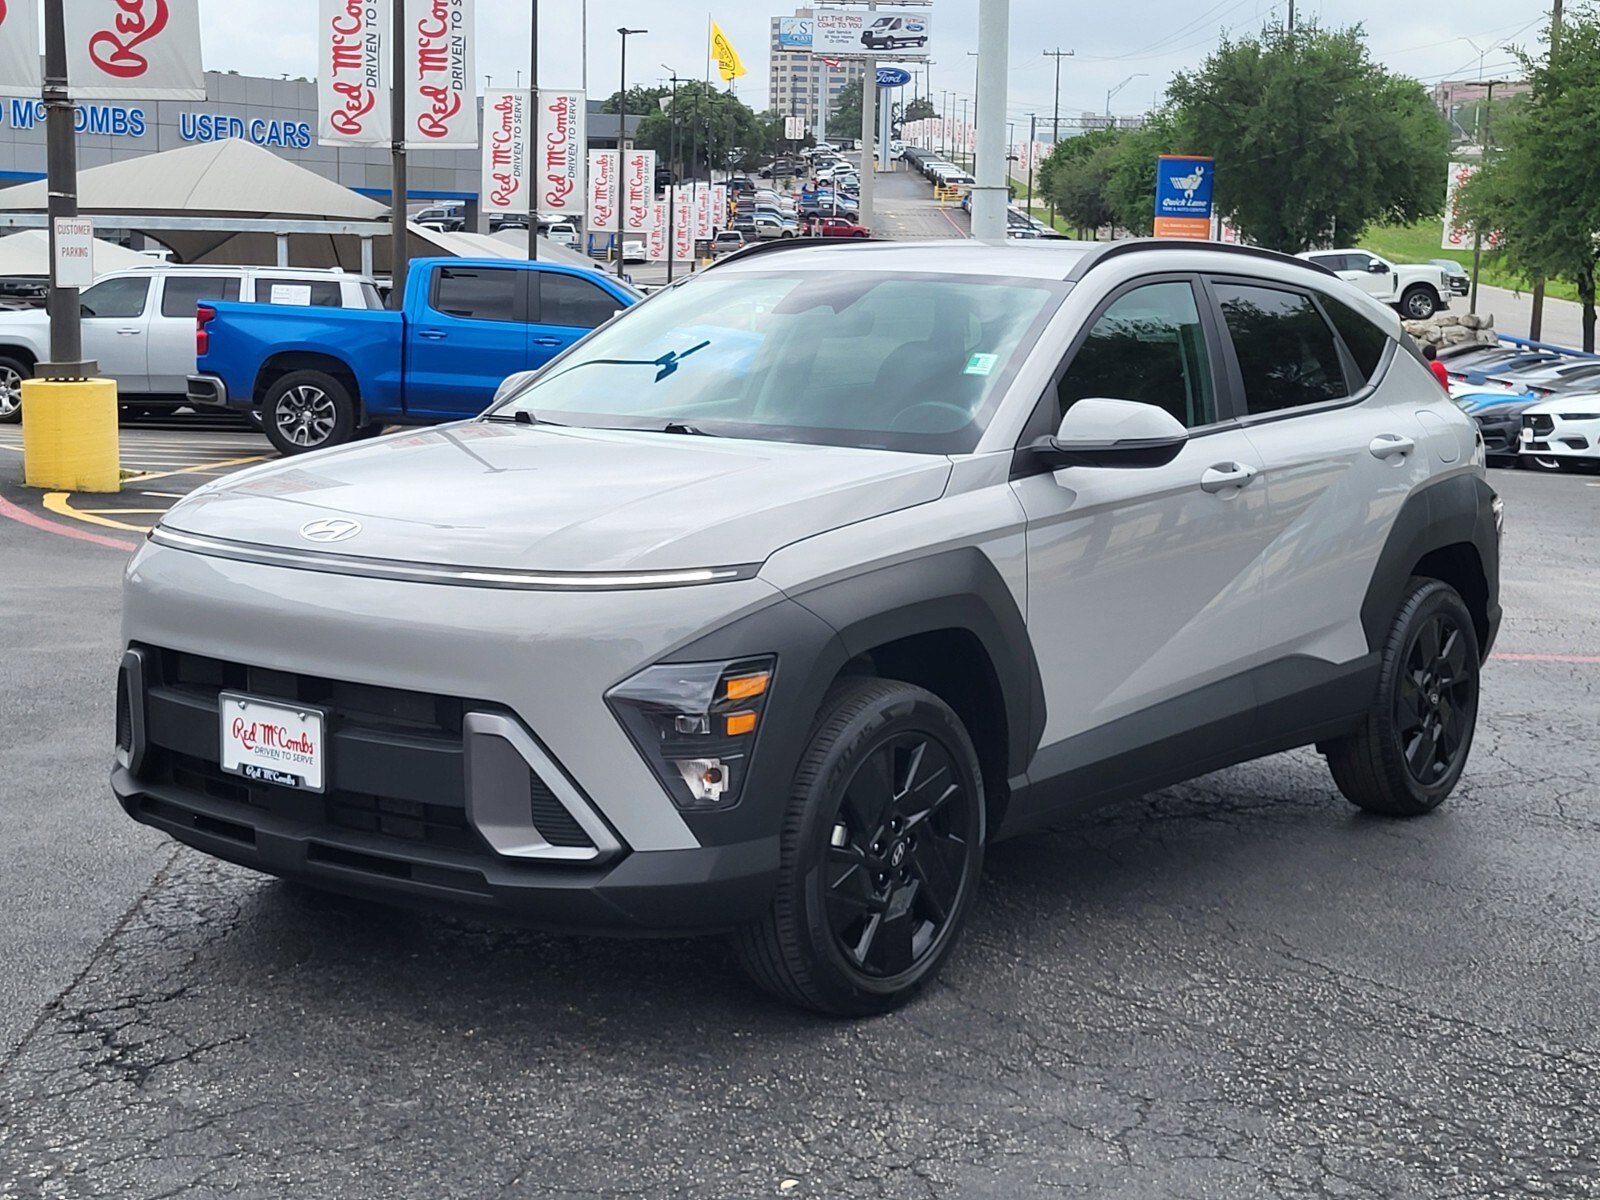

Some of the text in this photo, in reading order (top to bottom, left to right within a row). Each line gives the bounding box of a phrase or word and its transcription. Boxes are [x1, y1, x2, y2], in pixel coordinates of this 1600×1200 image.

[366, 8, 377, 28] TO
[452, 11, 462, 31] TO
[88, 0, 168, 78] Re
[366, 33, 377, 88] DRIVEN
[452, 35, 462, 91] DRIVEN
[876, 70, 903, 83] Ford
[331, 82, 375, 135] Red
[418, 85, 461, 138] Red
[514, 95, 522, 125] SERVE
[181, 113, 311, 148] USED CARS
[514, 127, 521, 141] TO
[568, 128, 575, 142] TO
[490, 95, 519, 206] Red McCombs
[545, 96, 573, 207] Red McCombs
[1162, 198, 1207, 207] Quick Lane
[593, 205, 612, 227] Red
[629, 206, 648, 228] Red
[58, 224, 90, 235] CUSTOMER
[61, 247, 88, 257] PARKING
[233, 717, 314, 755] Red McCombs
[254, 745, 314, 765] DRIVEN TO SERVE
